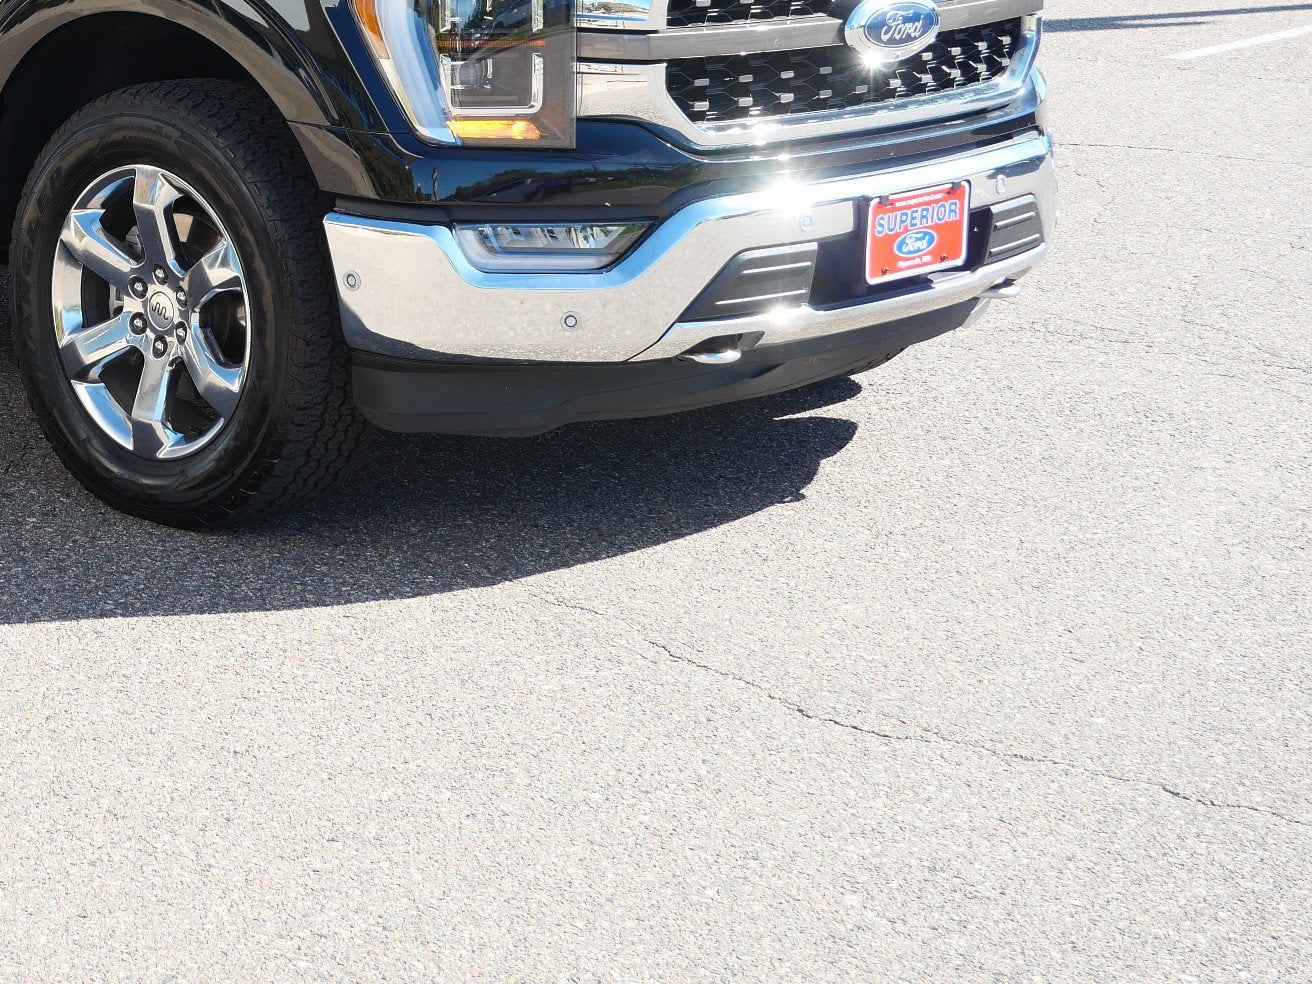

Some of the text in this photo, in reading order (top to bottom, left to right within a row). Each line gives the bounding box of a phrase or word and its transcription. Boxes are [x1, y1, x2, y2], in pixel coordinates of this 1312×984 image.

[880, 10, 925, 42] Ford
[875, 200, 959, 236] SUPERIOR
[901, 233, 929, 252] Ford
